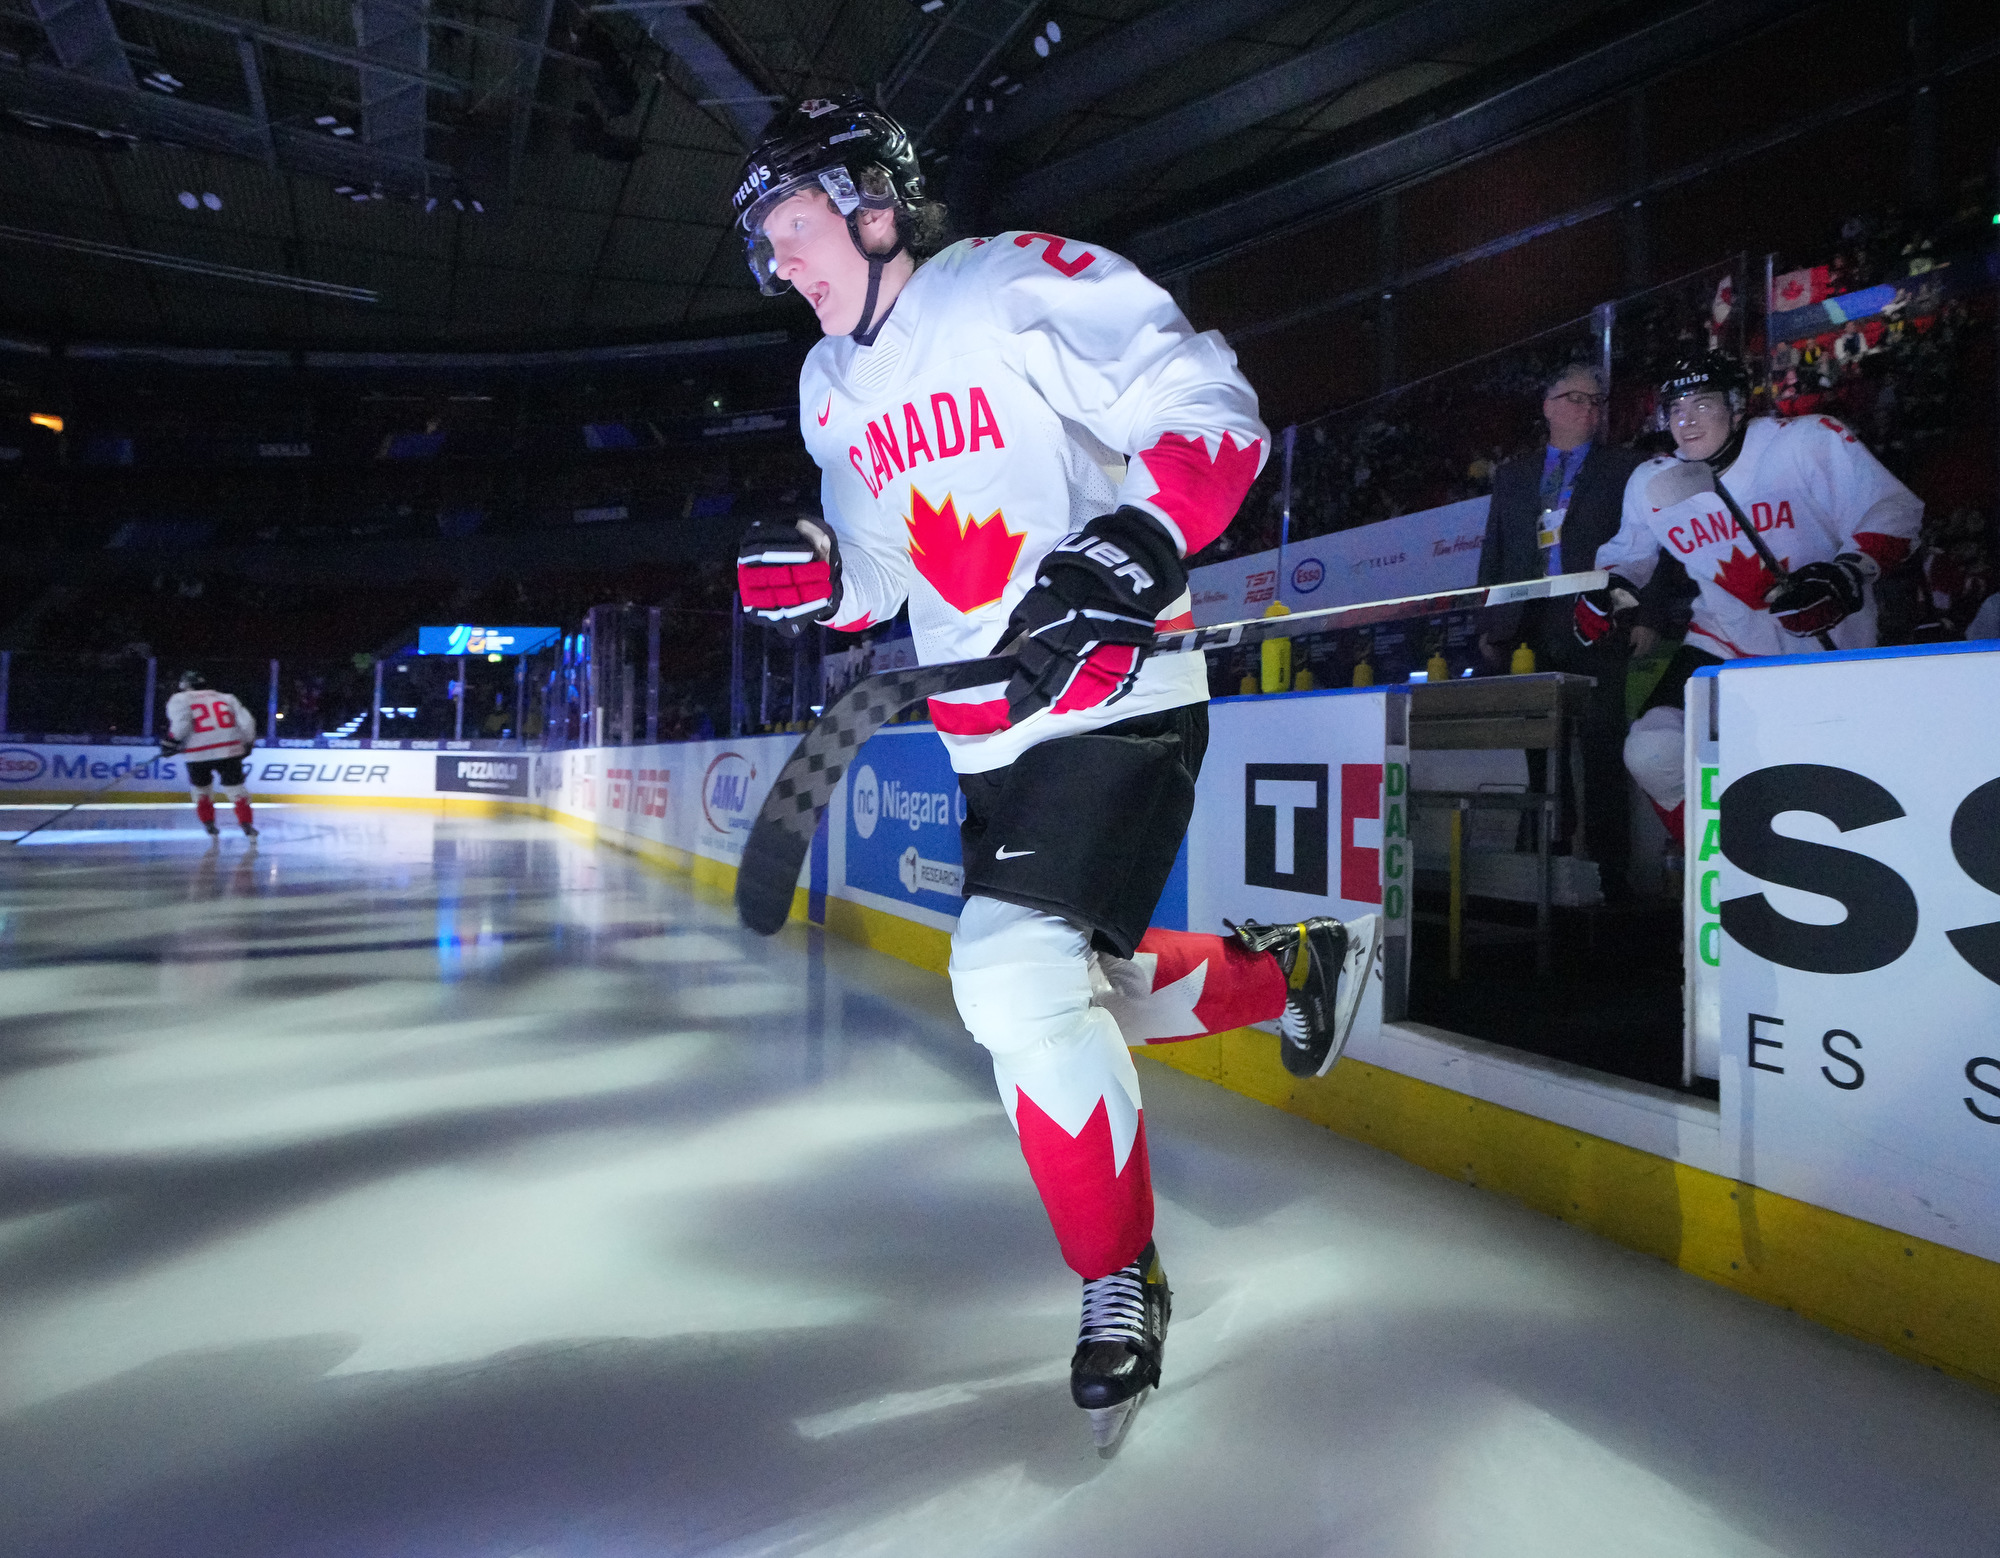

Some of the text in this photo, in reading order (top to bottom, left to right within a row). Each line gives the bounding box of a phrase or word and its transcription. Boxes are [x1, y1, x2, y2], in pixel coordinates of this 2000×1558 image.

[736, 165, 771, 206] TELUS
[1673, 373, 1709, 387] TELUS
[848, 387, 1005, 500] CANADA
[1370, 552, 1406, 568] TELUS
[190, 701, 236, 733] 26
[52, 753, 177, 780] Medals
[882, 780, 949, 831] Niagara
[1385, 762, 1406, 920] DACO
